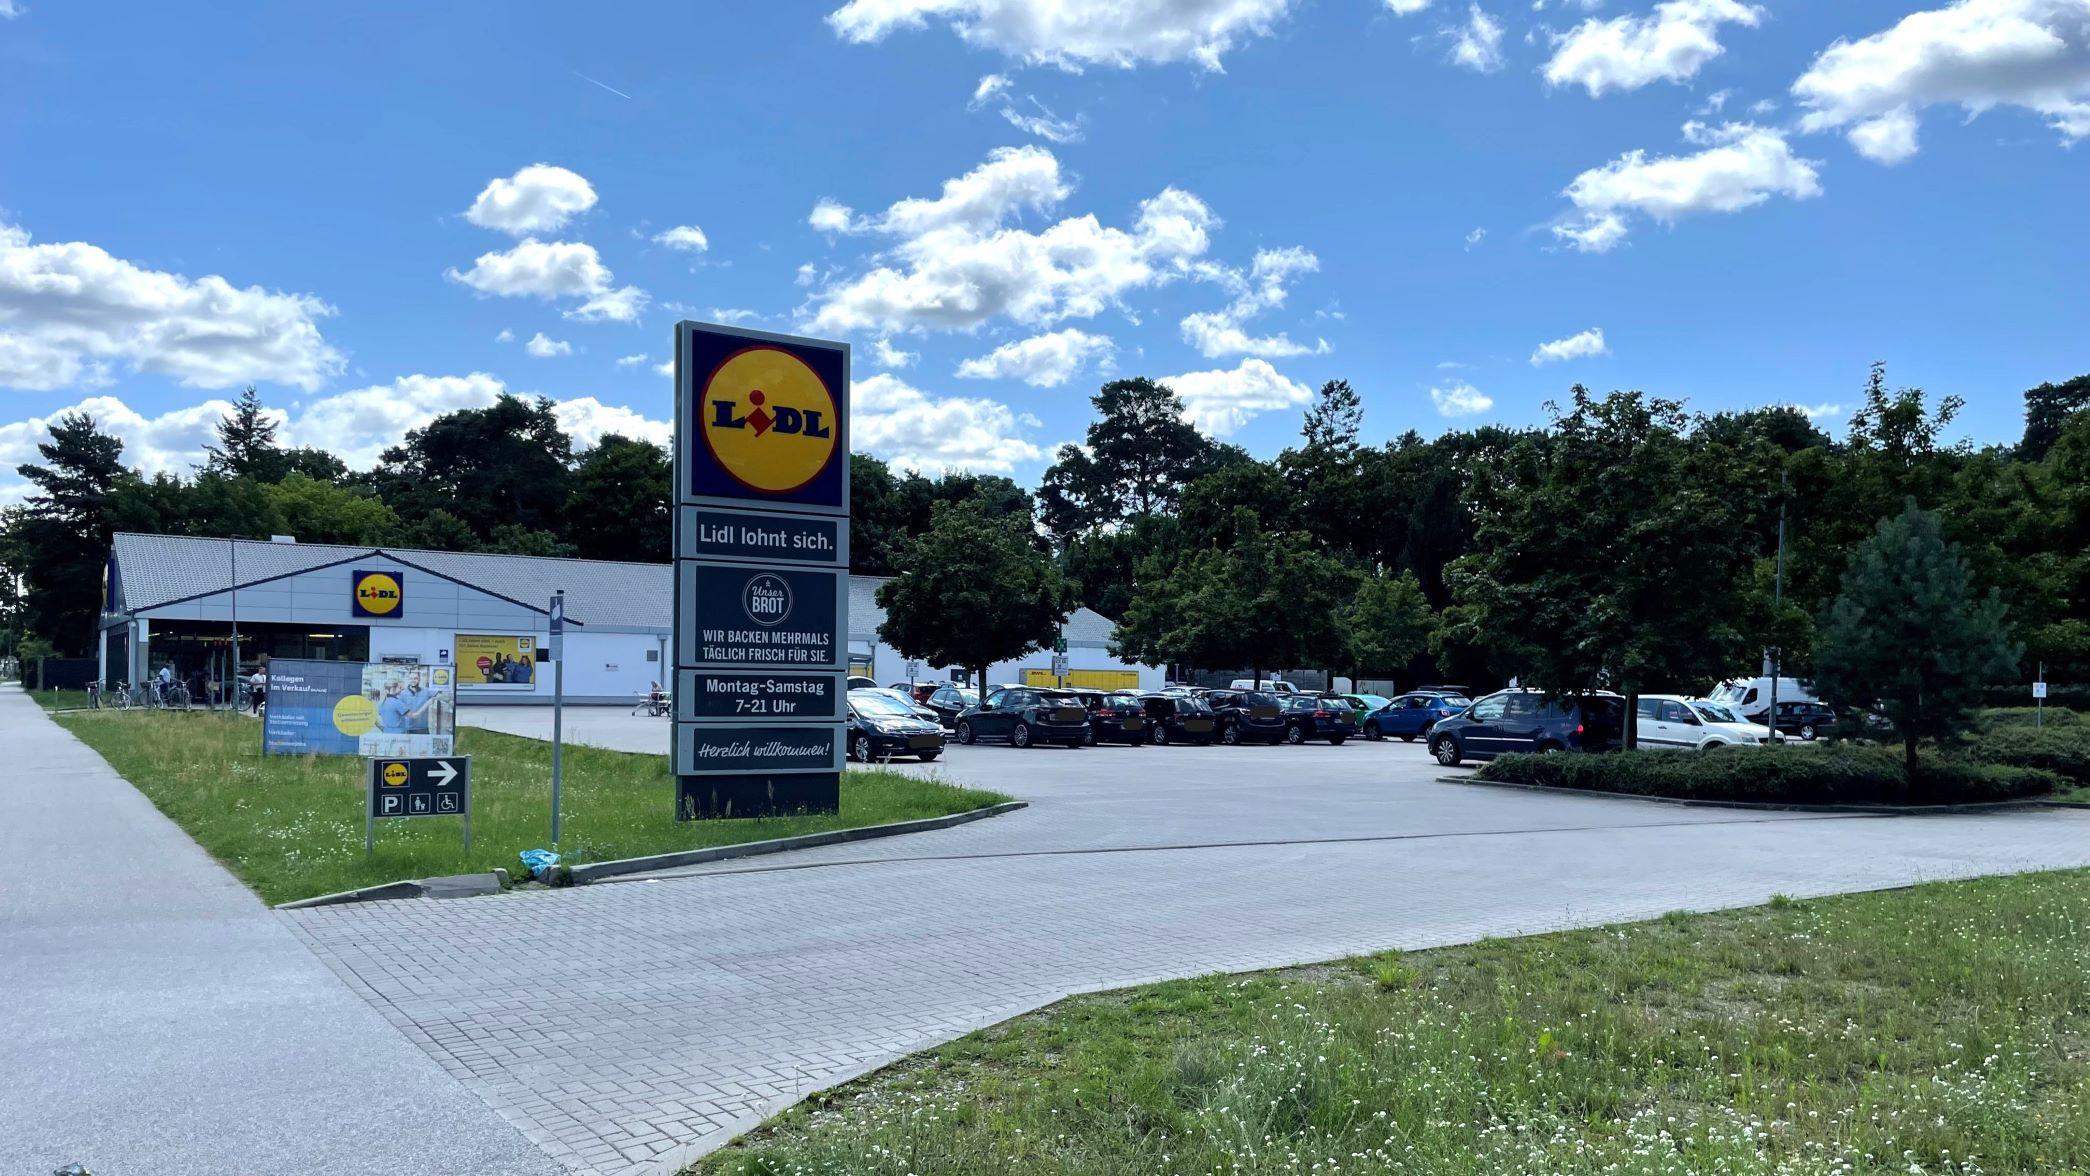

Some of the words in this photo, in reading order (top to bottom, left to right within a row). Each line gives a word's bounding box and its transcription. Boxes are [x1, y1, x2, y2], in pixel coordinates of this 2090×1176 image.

[700, 524, 734, 543] Lidl
[741, 527, 787, 547] lohnt
[793, 531, 833, 550] sich.
[752, 585, 784, 597] Unser
[752, 596, 784, 613] BROT
[703, 629, 724, 642] WIR
[728, 630, 769, 644] BACKEN
[771, 632, 829, 645] MEHRMALS
[703, 645, 745, 660] TÄGLICH
[748, 648, 785, 661] FRISCH
[788, 647, 808, 661] FÜR
[810, 649, 829, 662] SIE.
[270, 674, 304, 684] Kollegen
[706, 679, 825, 696] Montag-Samstag
[736, 699, 767, 713] 7-21
[773, 699, 797, 713] Uhr
[698, 740, 751, 758] Herzlich
[753, 741, 830, 757] willkommen!
[384, 796, 398, 813] P
